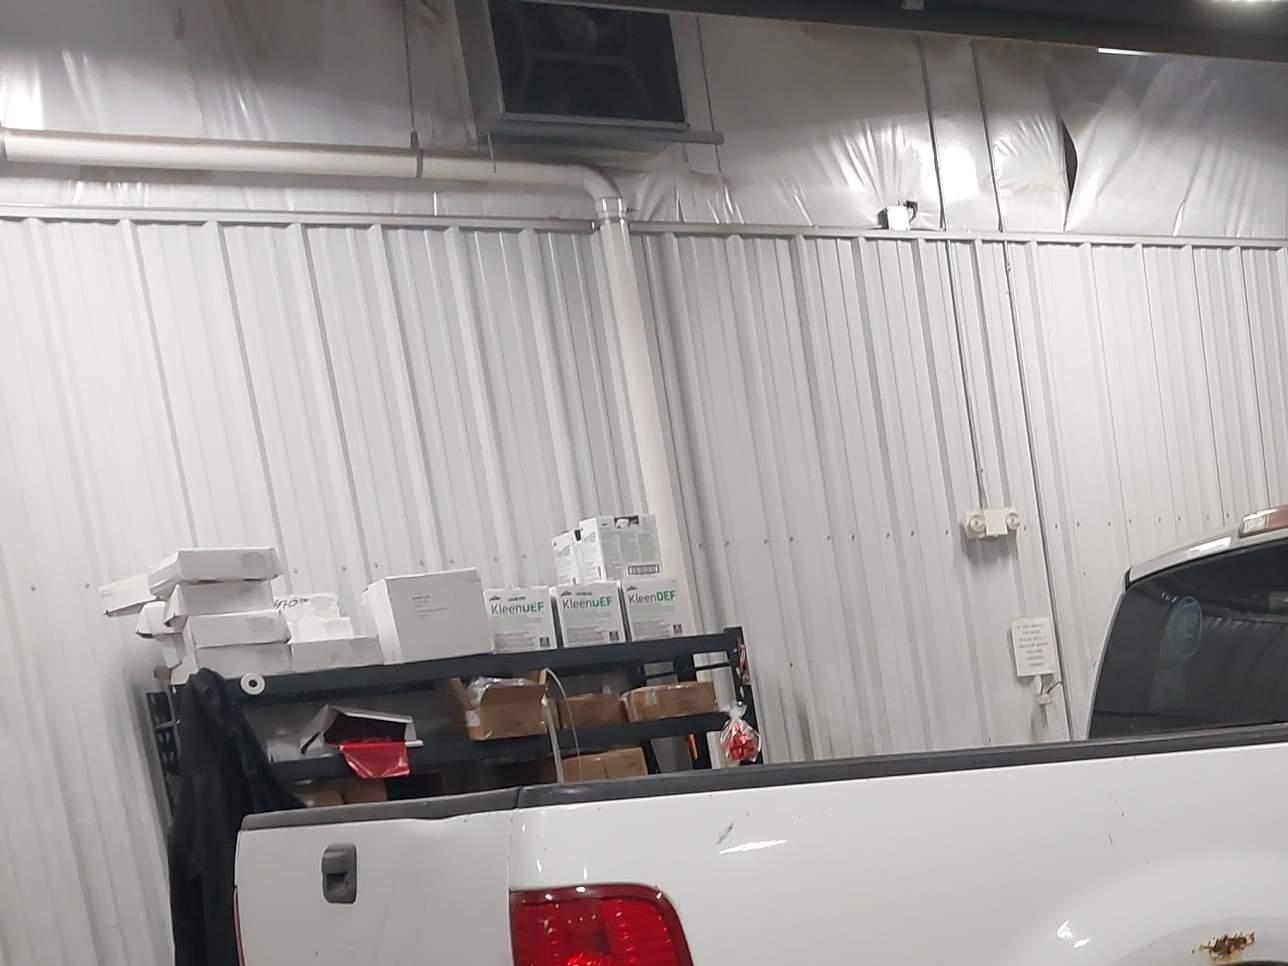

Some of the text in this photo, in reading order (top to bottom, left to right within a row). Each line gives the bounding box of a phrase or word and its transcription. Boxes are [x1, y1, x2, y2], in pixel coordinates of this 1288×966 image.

[562, 595, 613, 610] KleenDEF
[628, 590, 676, 604] KleenDEF
[491, 601, 545, 616] KleenDEF
